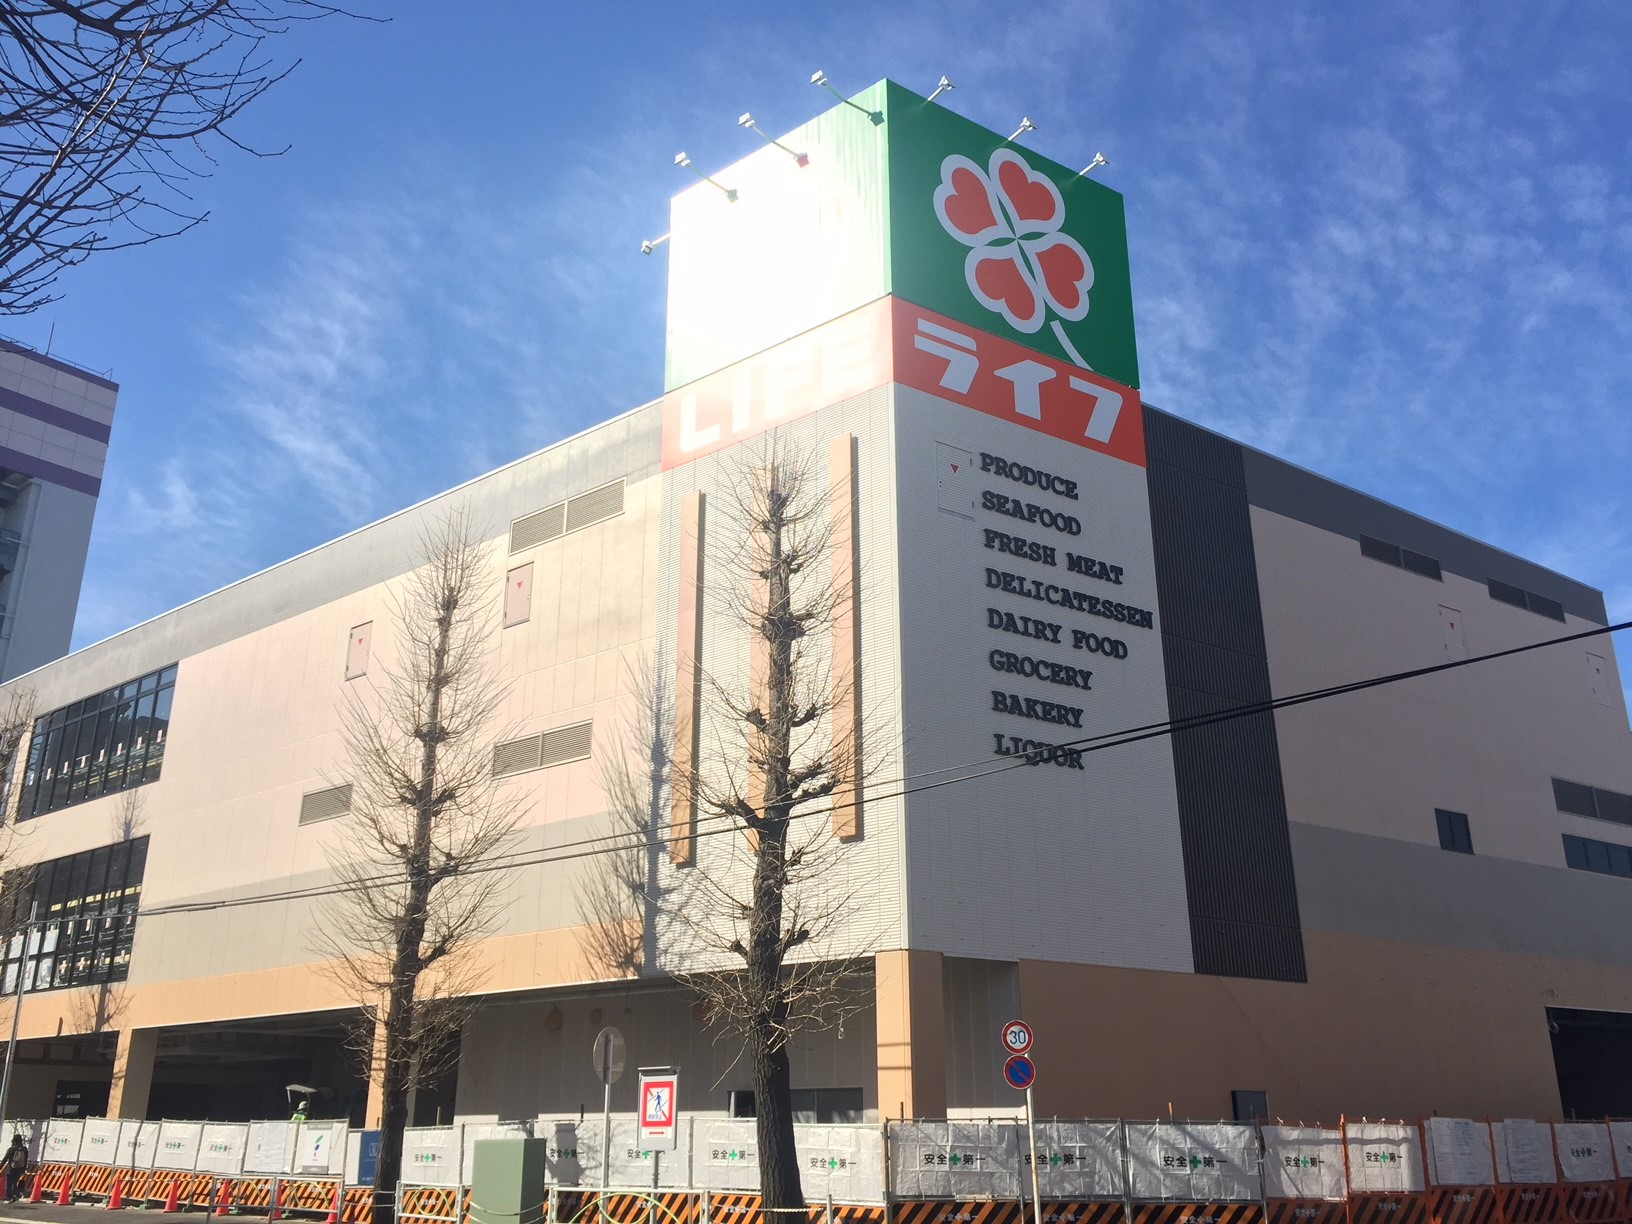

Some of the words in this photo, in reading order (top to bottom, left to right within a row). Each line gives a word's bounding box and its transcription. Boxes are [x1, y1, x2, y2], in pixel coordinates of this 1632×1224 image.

[679, 312, 872, 453] LIFE
[914, 318, 1124, 444] ライフ
[980, 452, 1078, 500] PRODUCE
[982, 490, 1082, 536] SEAFOOD
[984, 528, 1057, 567] FRESH
[1066, 552, 1123, 585] MEAT
[985, 567, 1153, 630] DELICATESSEN
[987, 607, 1062, 644] DAIRY
[1072, 629, 1128, 660] FOOD
[989, 649, 1093, 690] GROCERY
[992, 690, 1084, 728] BAKERY
[994, 733, 1085, 770] LIQUOR
[1009, 1030, 1027, 1045] 30
